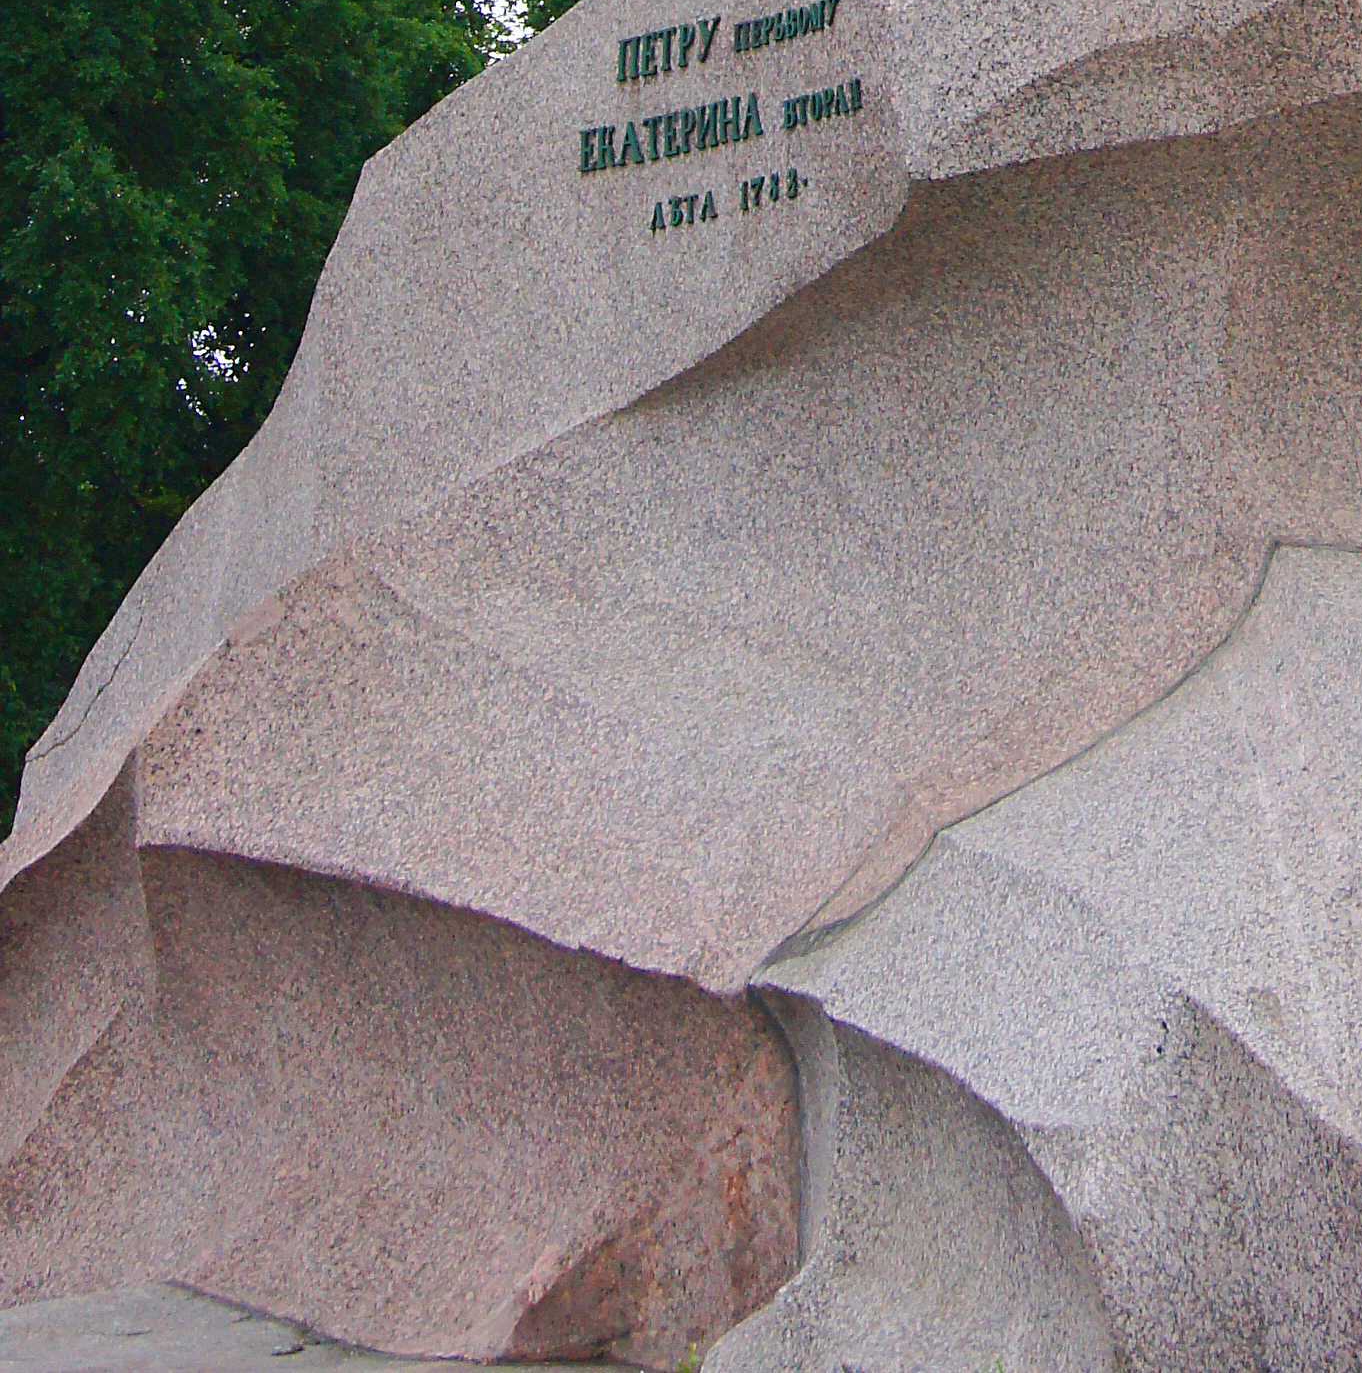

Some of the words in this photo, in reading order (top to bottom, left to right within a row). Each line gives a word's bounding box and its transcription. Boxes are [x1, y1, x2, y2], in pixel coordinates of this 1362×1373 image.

[617, 17, 721, 81] ПЕТРУ
[579, 93, 763, 172] ЕКАТЕРИНА
[782, 78, 863, 129] ВТОРАЯ
